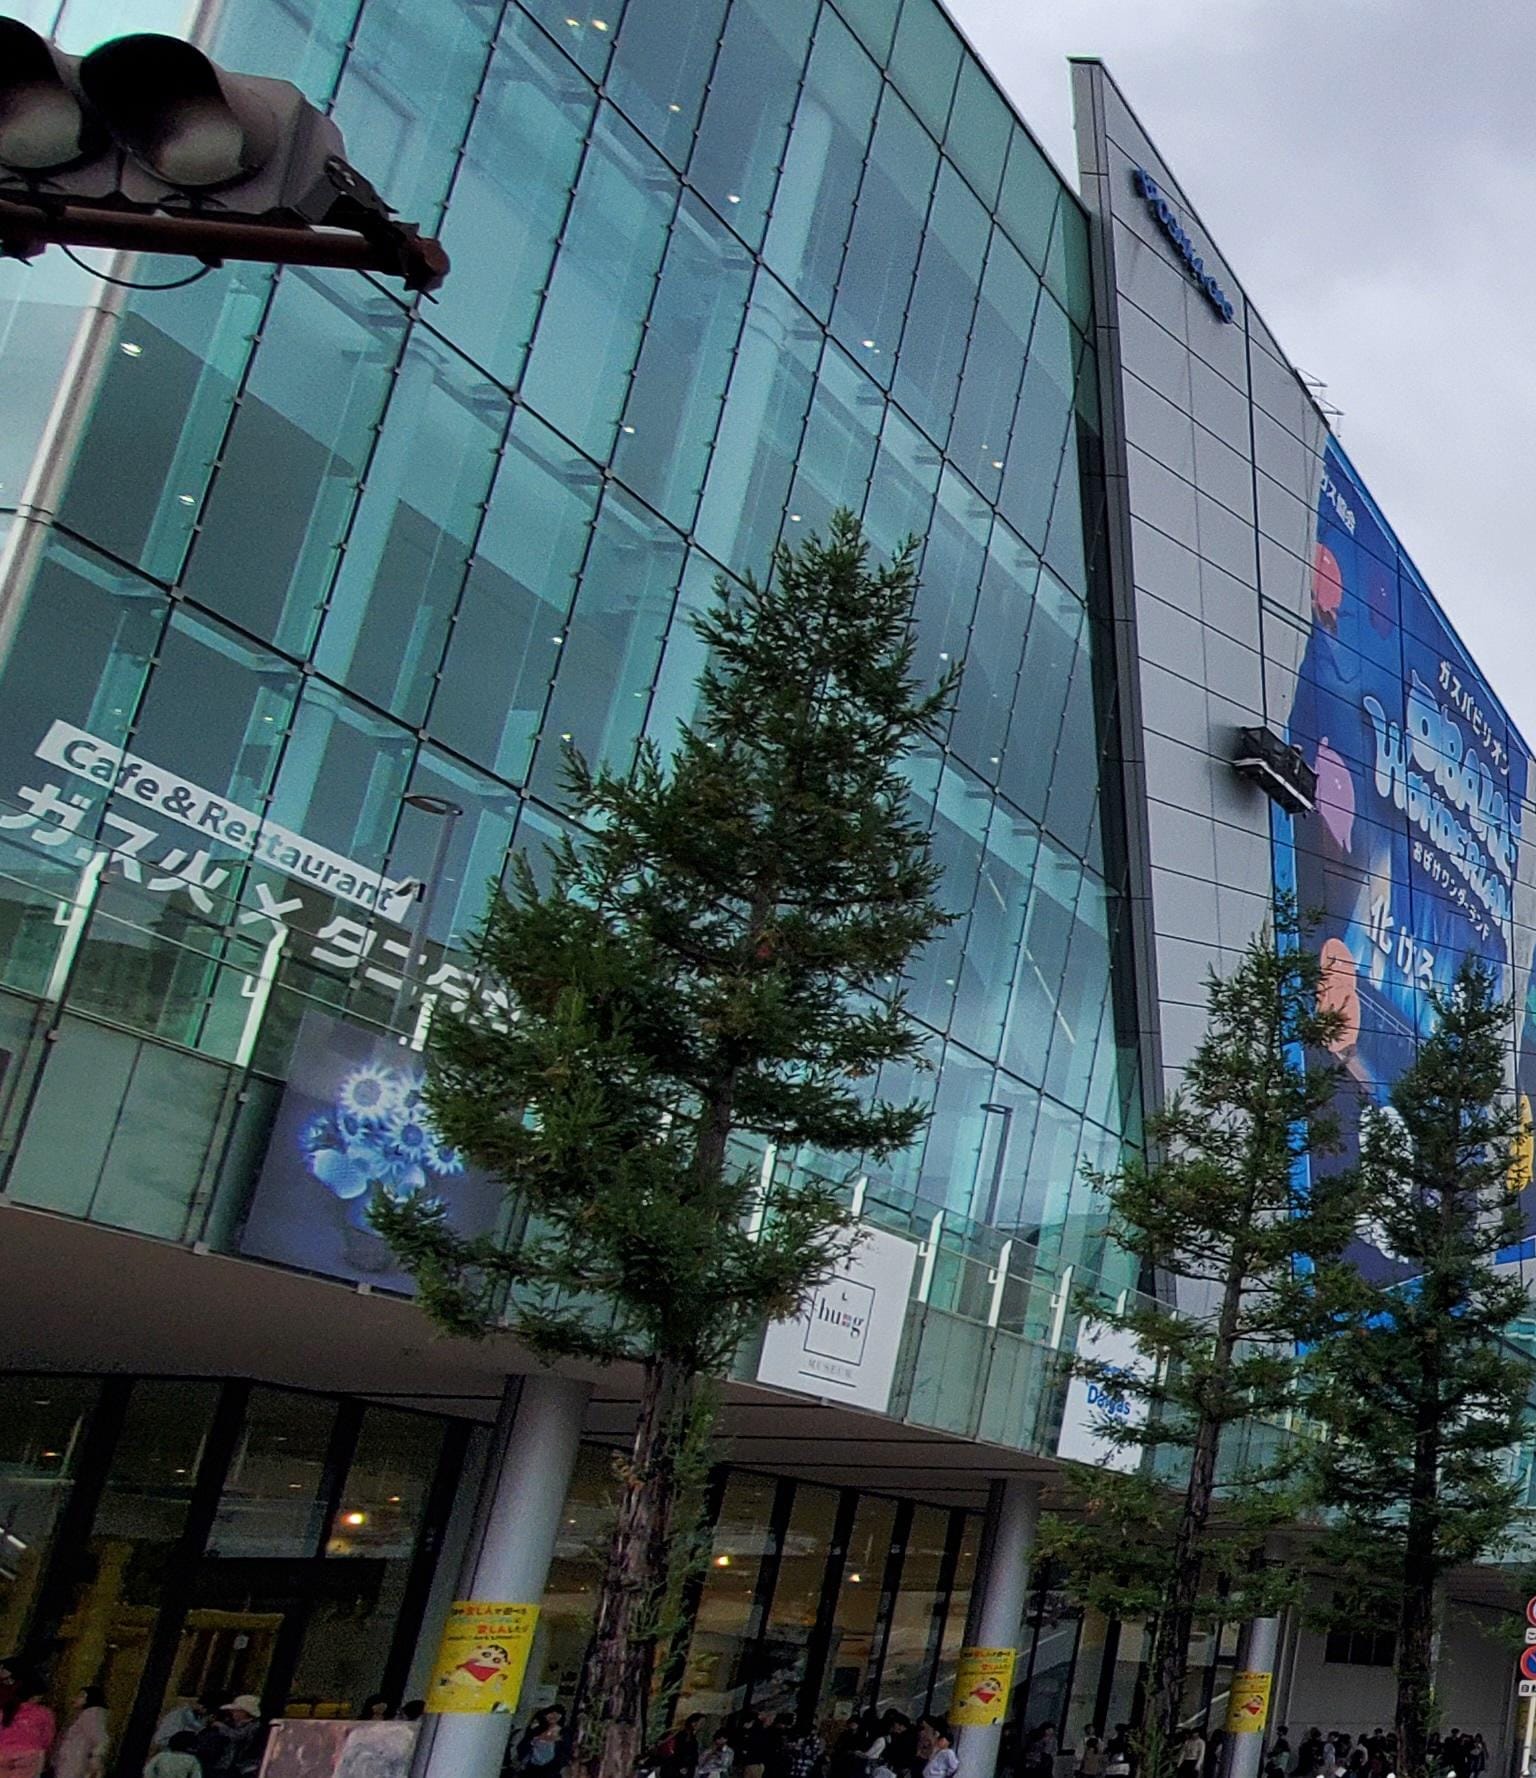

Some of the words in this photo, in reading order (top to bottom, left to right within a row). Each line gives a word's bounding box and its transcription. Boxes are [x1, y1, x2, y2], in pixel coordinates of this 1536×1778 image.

[1439, 661, 1509, 776] ガスパビリオン
